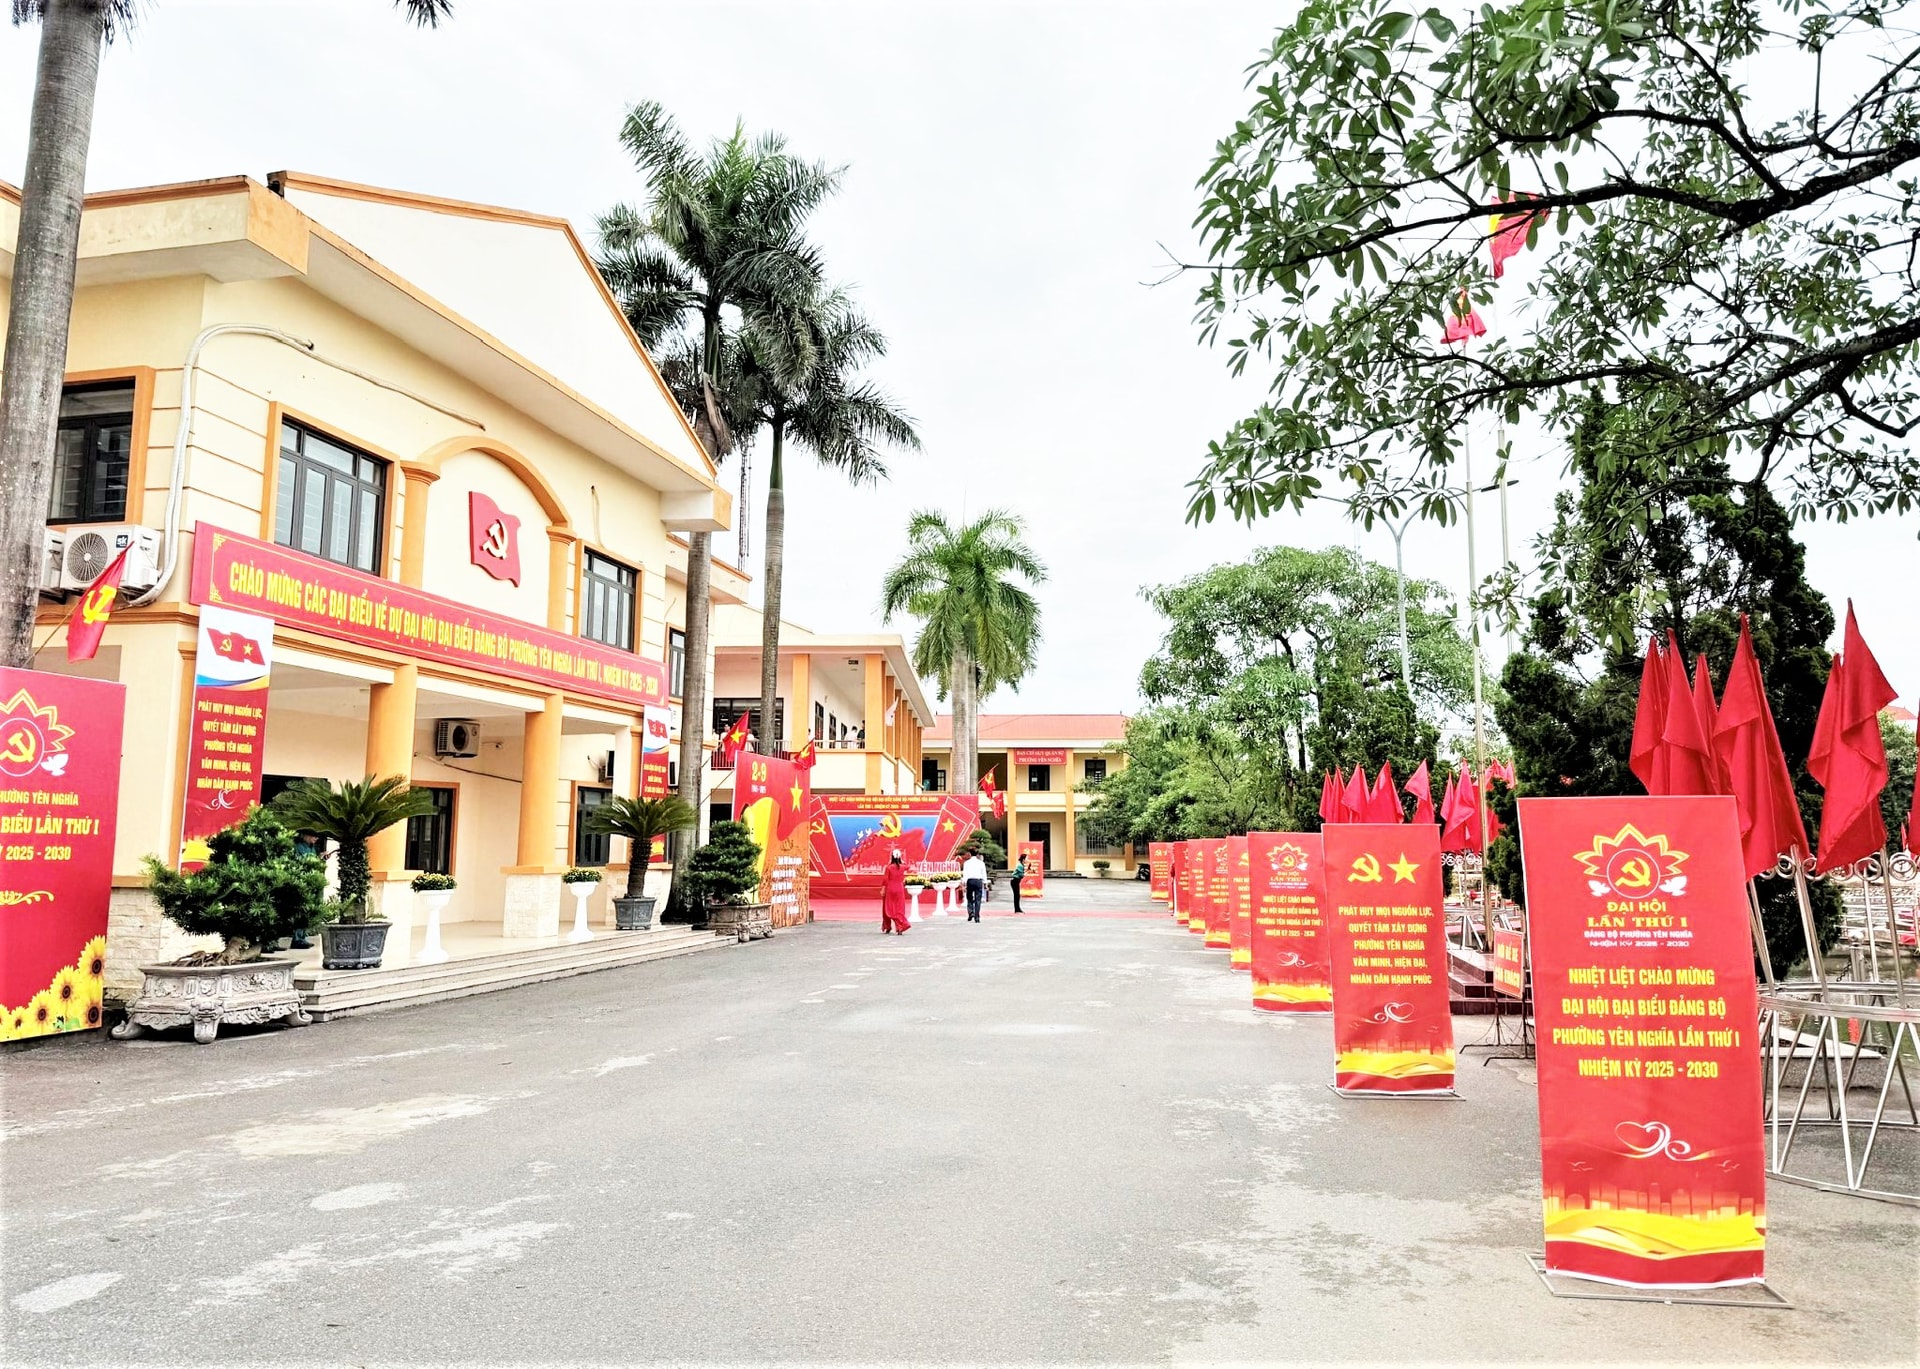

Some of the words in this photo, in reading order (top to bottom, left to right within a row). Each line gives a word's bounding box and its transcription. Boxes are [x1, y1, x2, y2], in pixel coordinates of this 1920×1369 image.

[230, 560, 264, 598] CHÀO
[267, 568, 301, 608] MỪNG
[305, 580, 326, 615] CÁC
[329, 590, 347, 624] ĐẠI
[350, 588, 372, 627] BIỂU
[375, 596, 388, 630] VỀ
[389, 606, 402, 639] DỰ
[404, 610, 419, 643] ĐẠI
[422, 612, 436, 647] HỘI
[438, 620, 453, 651] ĐẠI
[455, 618, 473, 651] BIỂU
[475, 624, 496, 658] ĐẢNG
[497, 632, 507, 664] BỘ
[509, 637, 538, 668] PHƯỜNG
[539, 644, 552, 670] YÊN
[32, 790, 50, 804] YÊN
[52, 792, 78, 806] NGHĨA
[1, 809, 33, 834] BIỂU
[35, 810, 63, 834] LẦN
[66, 816, 92, 835] THỨ
[6, 846, 34, 860] 2025
[44, 846, 71, 860] 2030
[1338, 905, 1358, 916] PHÁT
[1360, 906, 1374, 916] HUY
[1376, 906, 1390, 918] MỌI
[1419, 906, 1434, 918] LỰC,
[1607, 901, 1633, 914] ĐẠI
[1639, 898, 1666, 914] HỘI
[1349, 921, 1372, 933] QUYẾT
[1374, 922, 1389, 933] TÂM
[1391, 922, 1406, 933] XÂY
[1408, 923, 1427, 935] DỰNG
[1632, 916, 1674, 928] THỨ
[1584, 930, 1606, 938] ĐẢNG
[1607, 930, 1618, 939] BỘ
[1620, 930, 1651, 938] PHƯỜNG
[1652, 930, 1668, 938] YÊN
[1354, 938, 1384, 950] PHƯỜNG
[1386, 938, 1400, 950] YÊN
[1402, 938, 1425, 950] NGHĨA
[1590, 940, 1617, 948] NHIỆM
[1350, 974, 1372, 984] NHÂN
[1374, 973, 1389, 984] DÂN
[1391, 975, 1411, 986] HẠNH
[1413, 974, 1432, 984] PHÚC
[1569, 966, 1605, 988] NHIỆT
[1609, 966, 1635, 988] LIỆT
[1639, 966, 1672, 985] CHÀO
[1676, 966, 1715, 985] MỪNG
[1562, 999, 1583, 1018] ĐẠI
[1587, 996, 1609, 1018] HỘI
[1612, 999, 1634, 1018] ĐẠI
[1638, 994, 1665, 1015] BIỂU
[1670, 995, 1705, 1016] ĐẢNG
[1709, 997, 1726, 1019] BỘ
[1553, 1025, 1605, 1045] PHƯỜNG
[1608, 1026, 1634, 1046] YÊN
[1637, 1027, 1675, 1046] NGHĨA
[1679, 1025, 1704, 1046] LẦN
[1707, 1027, 1732, 1047] THỨ
[1736, 1032, 1740, 1047] I
[1579, 1057, 1621, 1080] NHIỆM
[1625, 1058, 1640, 1077] KỲ
[1645, 1061, 1674, 1077] 2025
[1686, 1061, 1718, 1078] 2030
